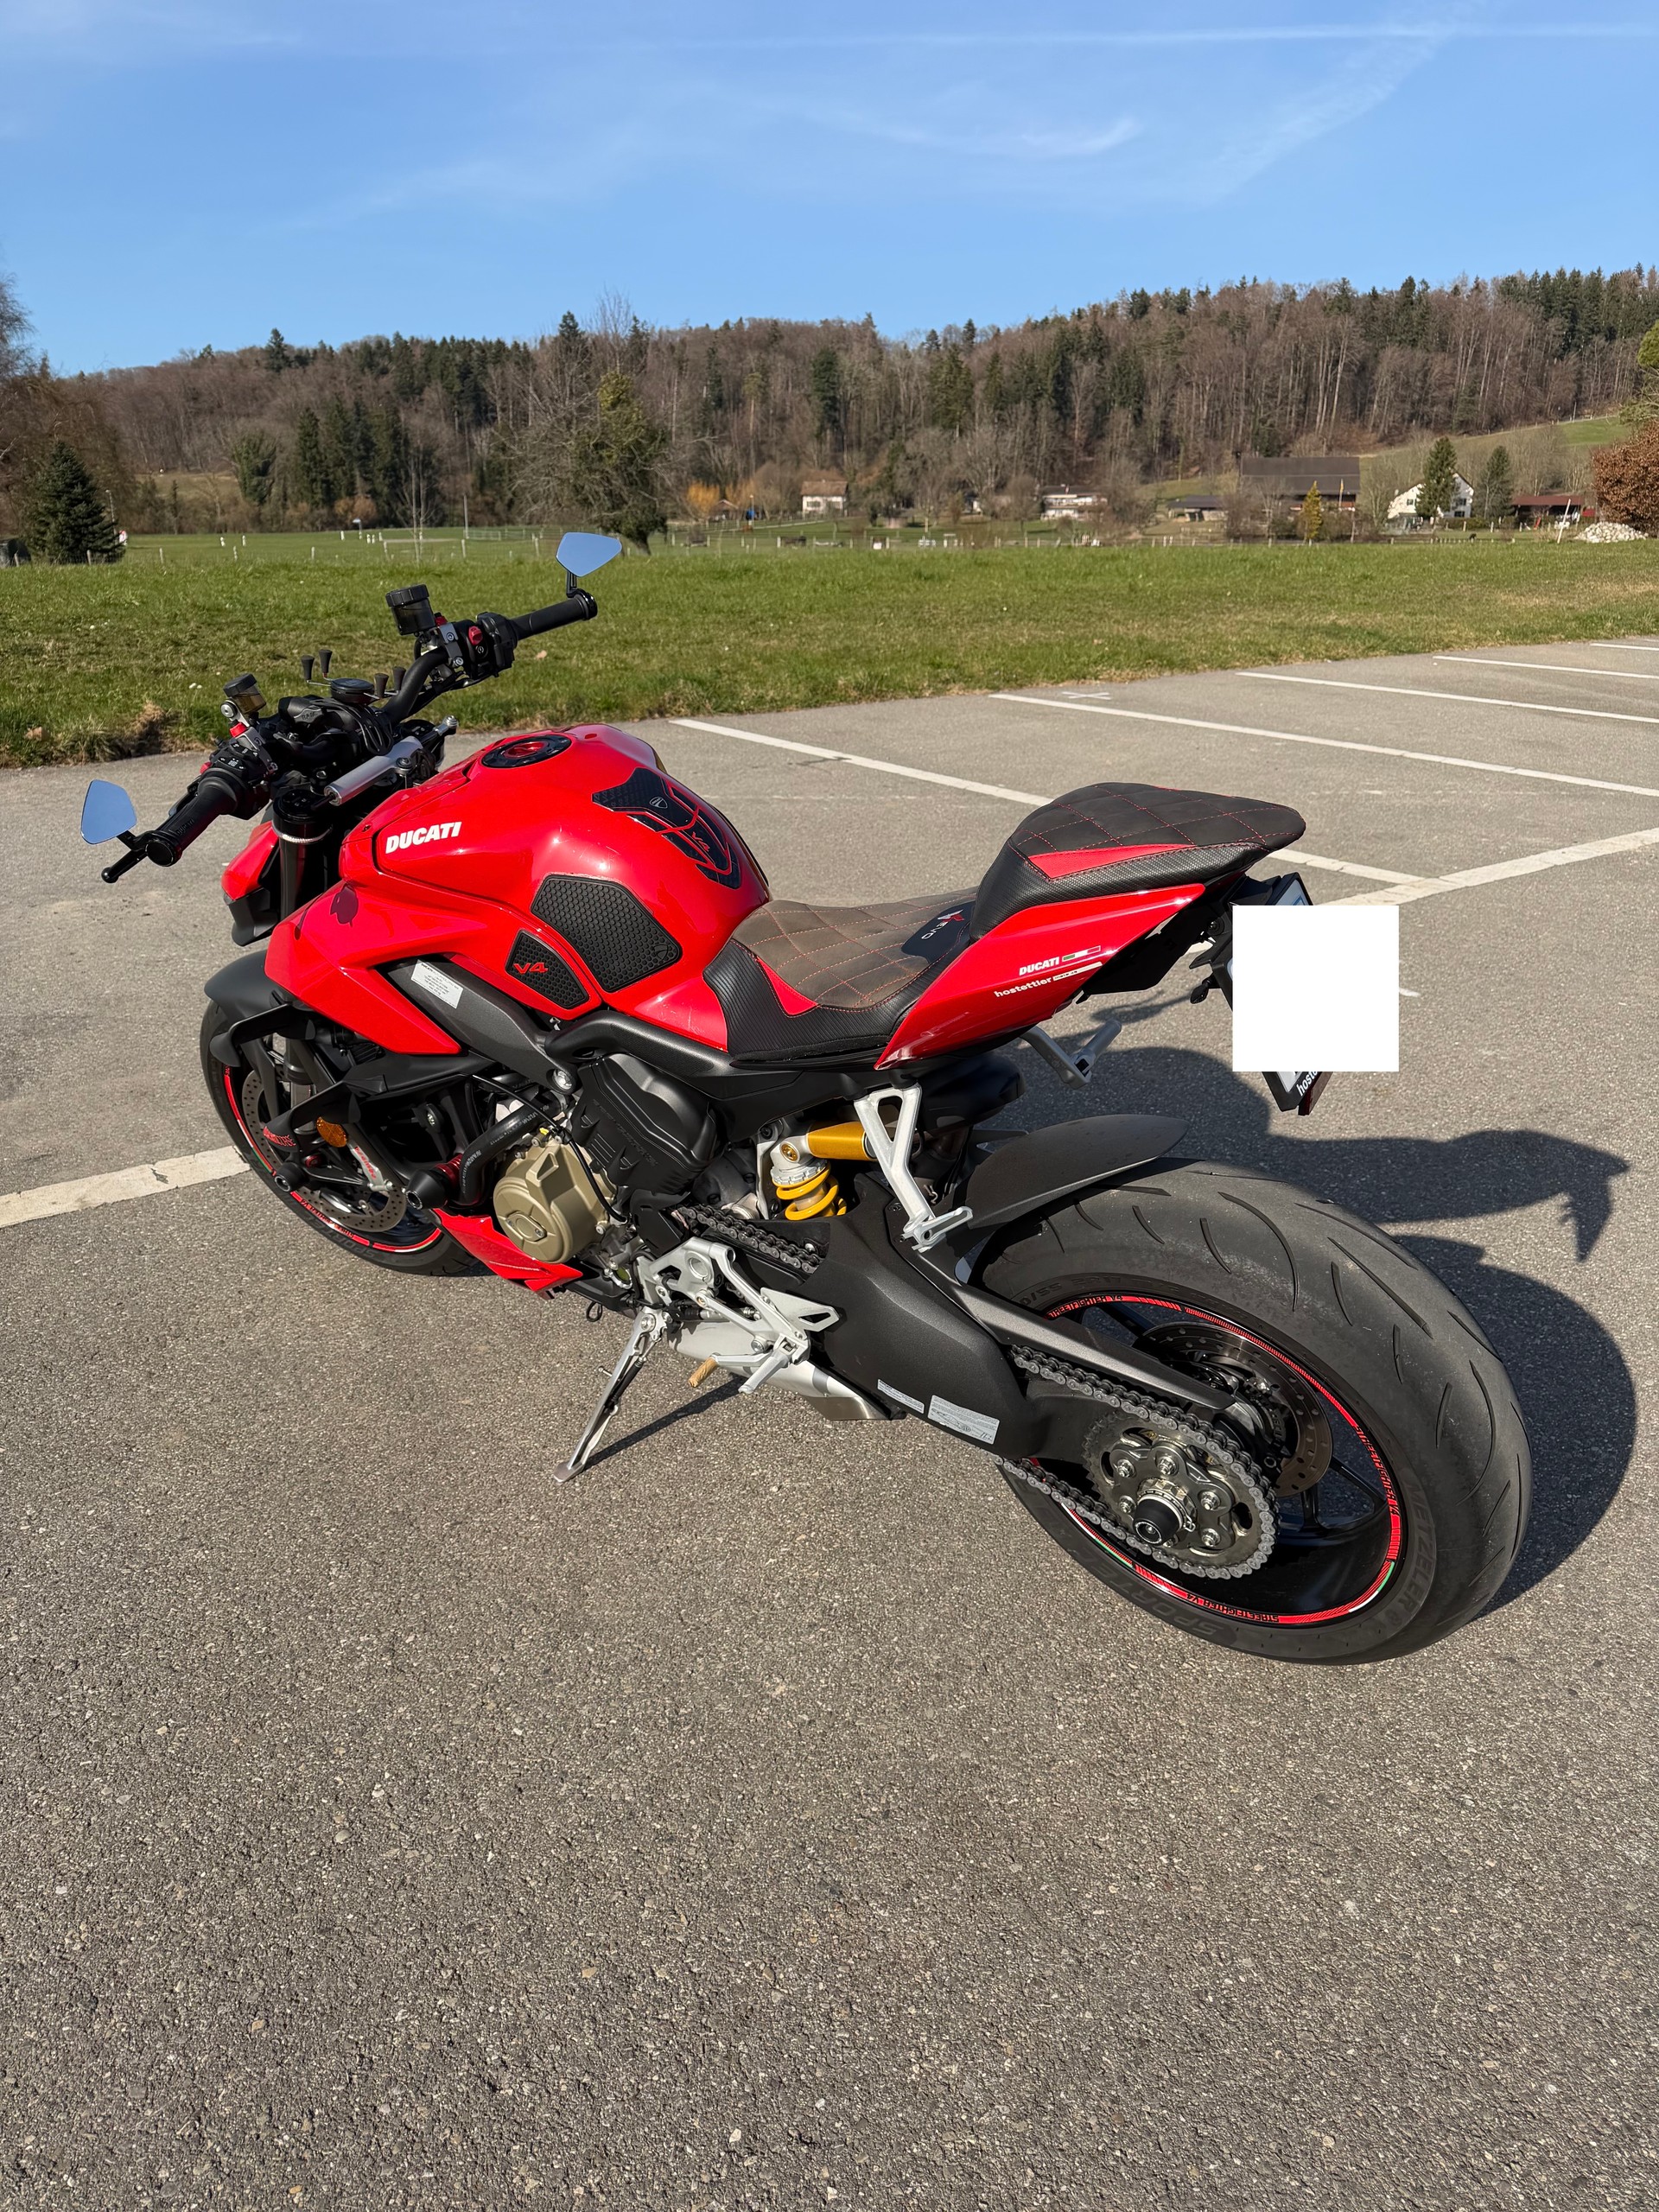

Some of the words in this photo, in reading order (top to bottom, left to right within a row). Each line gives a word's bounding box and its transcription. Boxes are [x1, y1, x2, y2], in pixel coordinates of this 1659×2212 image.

[385, 821, 462, 855] DUCATI
[692, 831, 711, 852] V4
[513, 962, 549, 975] V4
[1019, 957, 1060, 976] DUCATI
[994, 976, 1053, 998] hostettler
[1397, 1484, 1434, 1612] METZELER
[1186, 1592, 1201, 1604] V4
